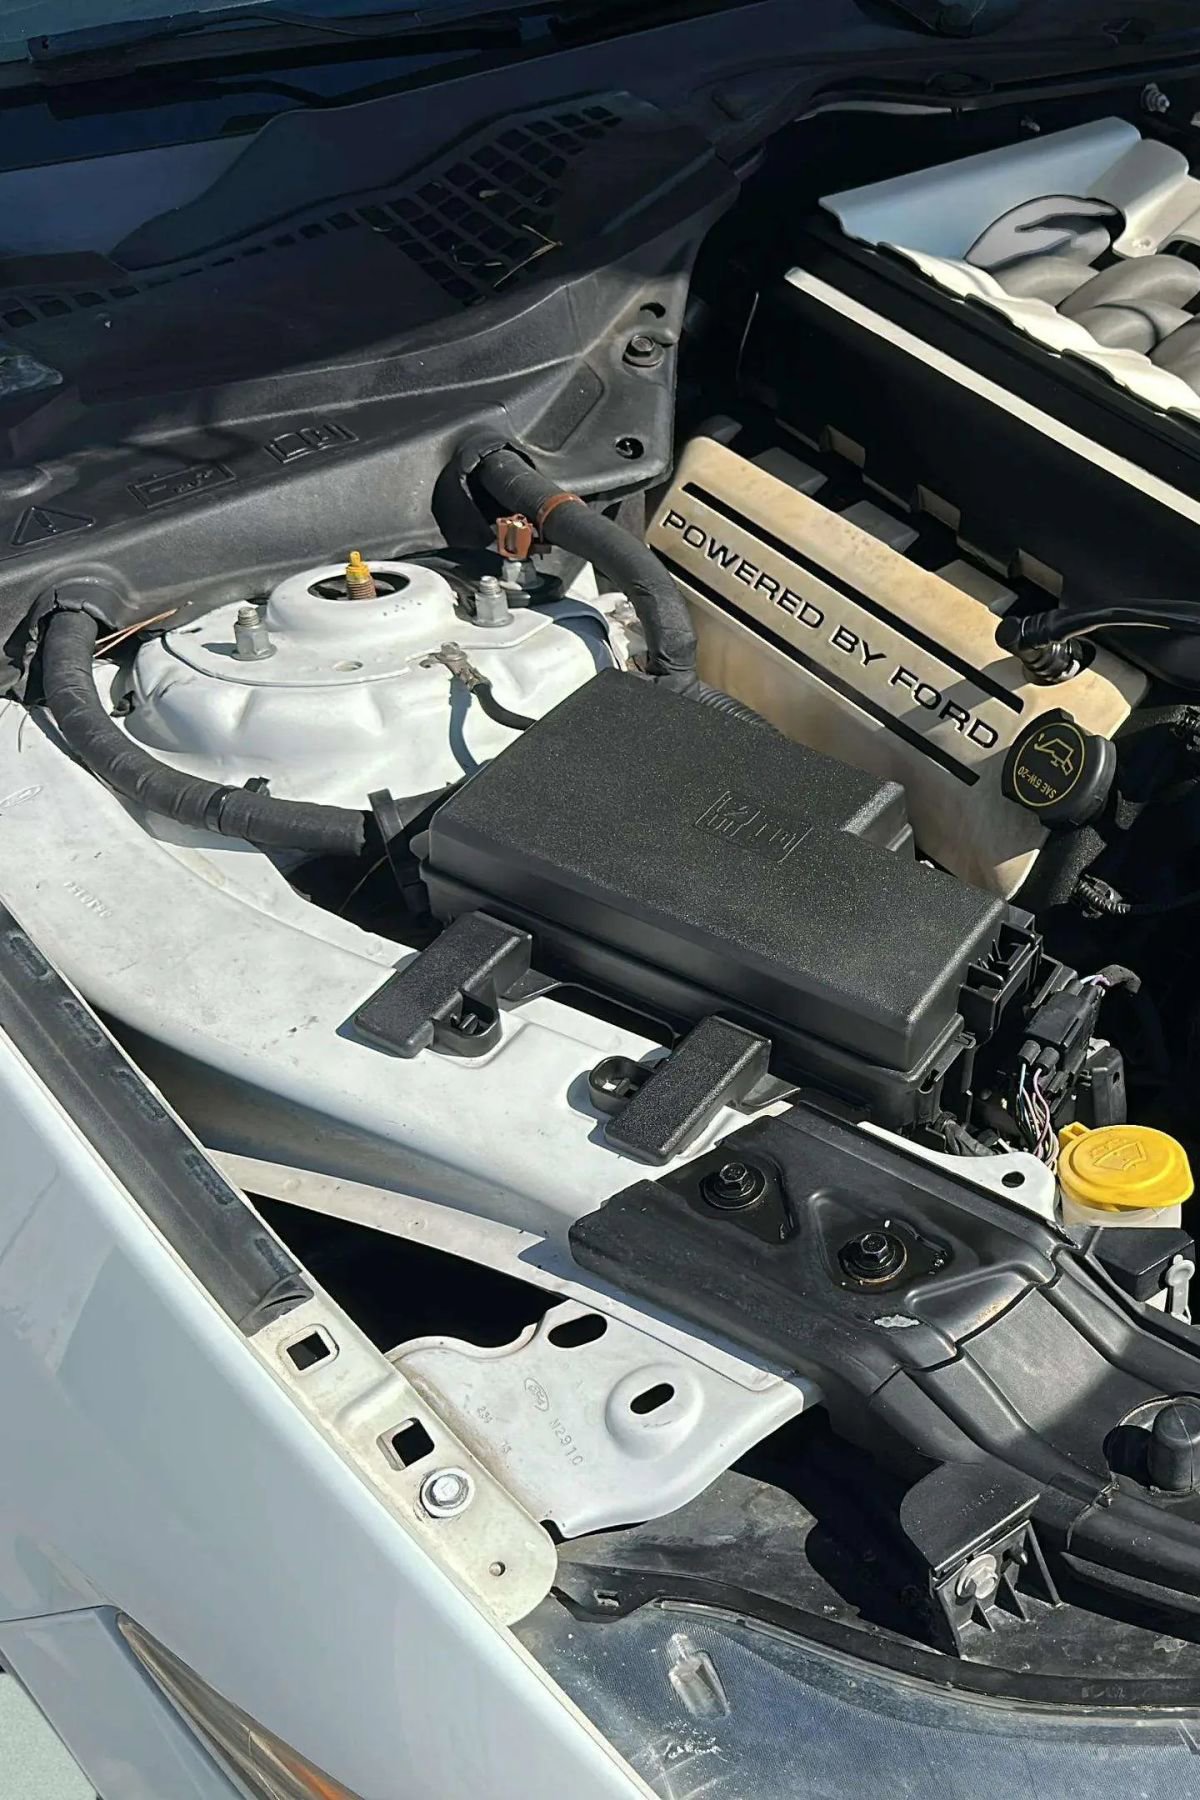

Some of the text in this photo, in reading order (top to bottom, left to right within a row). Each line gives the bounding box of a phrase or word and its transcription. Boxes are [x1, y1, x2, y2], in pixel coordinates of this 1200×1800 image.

[660, 510, 999, 749] POWERED BY FORD
[1017, 766, 1057, 799] SAE 5W-20
